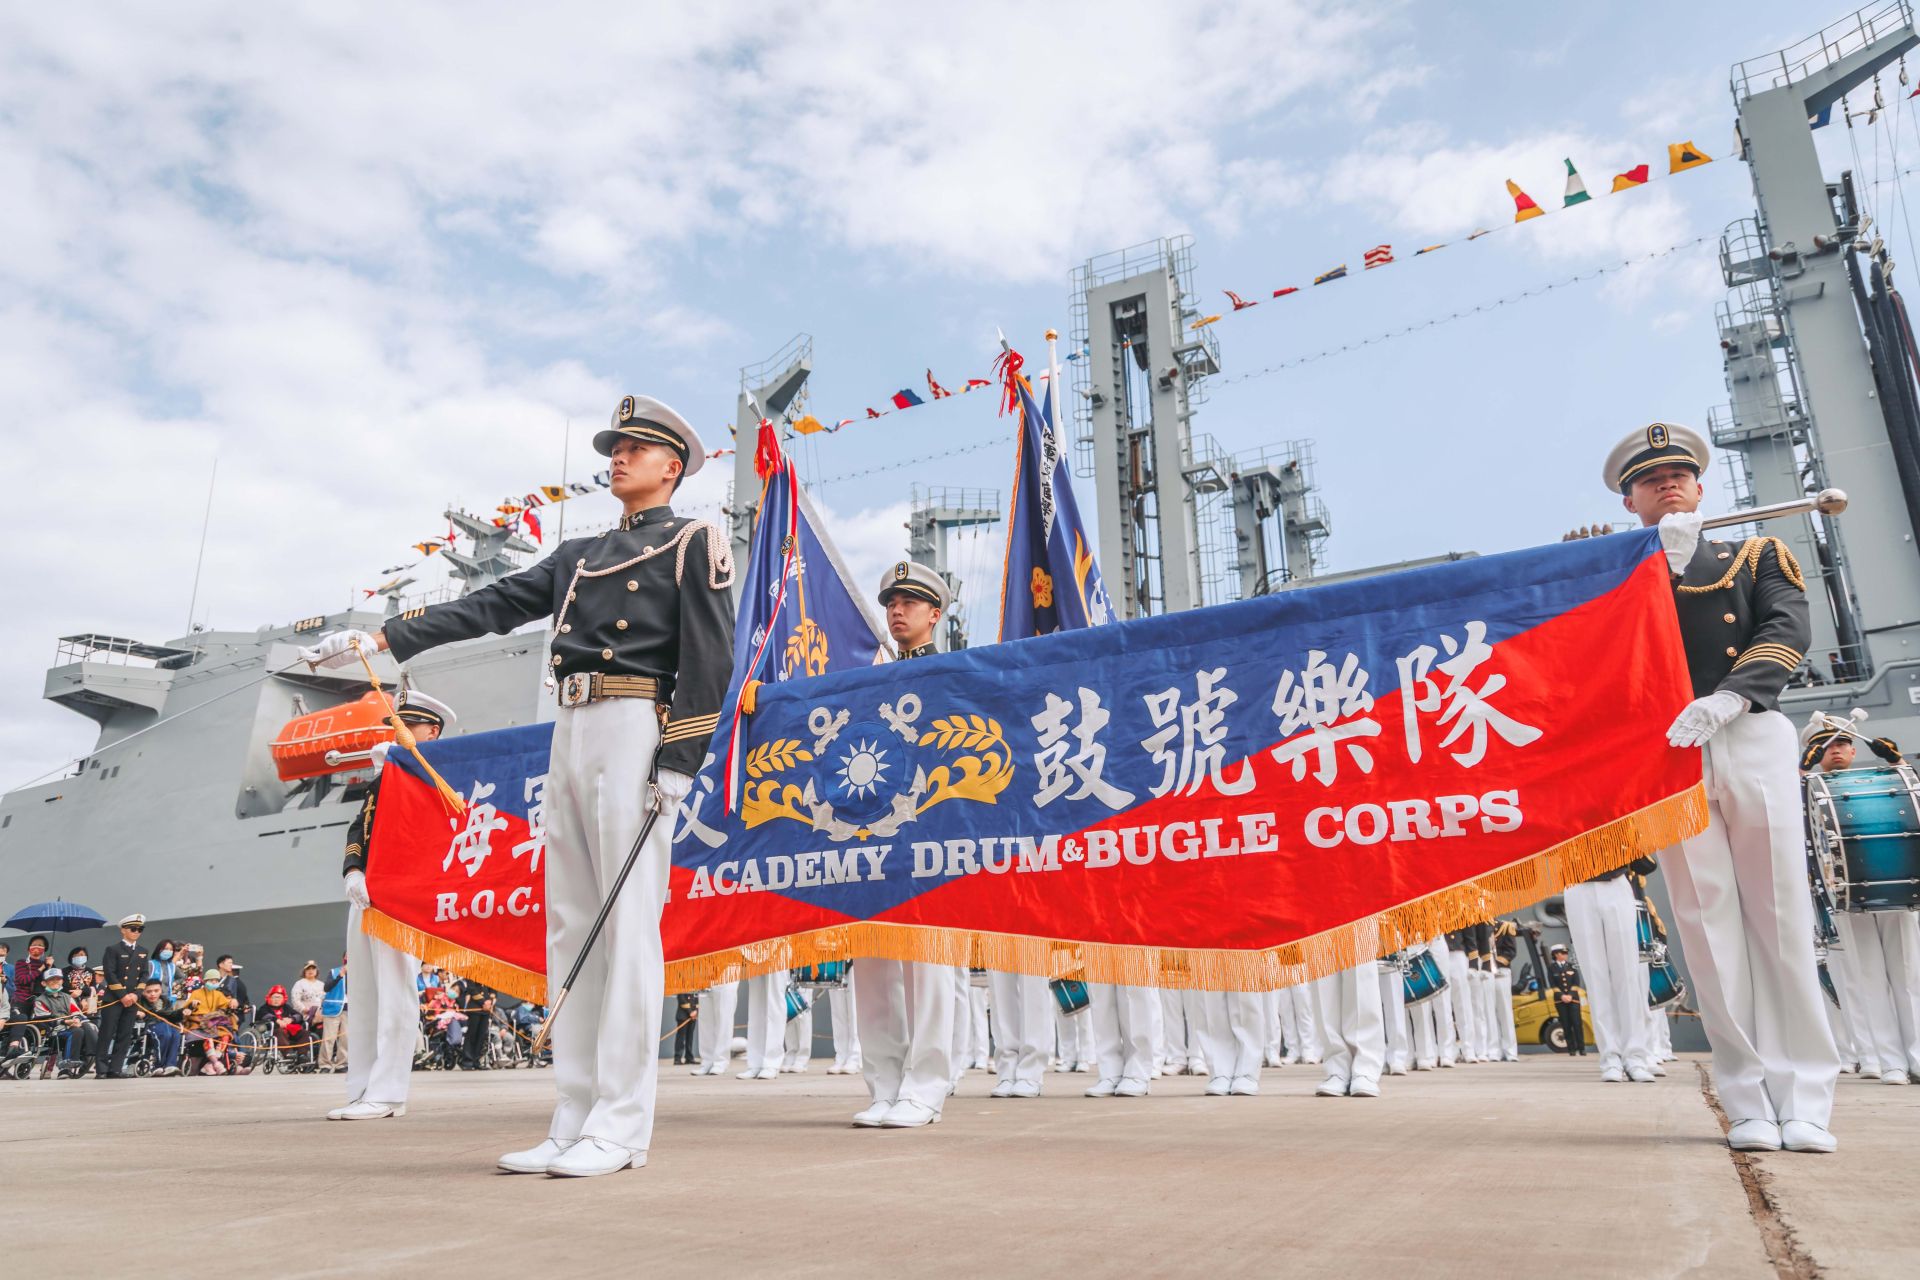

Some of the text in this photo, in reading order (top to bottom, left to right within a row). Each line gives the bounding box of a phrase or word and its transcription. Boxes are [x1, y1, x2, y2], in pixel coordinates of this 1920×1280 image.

[1030, 619, 1544, 811] 鼓號樂隊
[435, 886, 541, 922] R.O.C.
[687, 844, 893, 899] ACADEMY
[1304, 789, 1524, 849] CORPS
